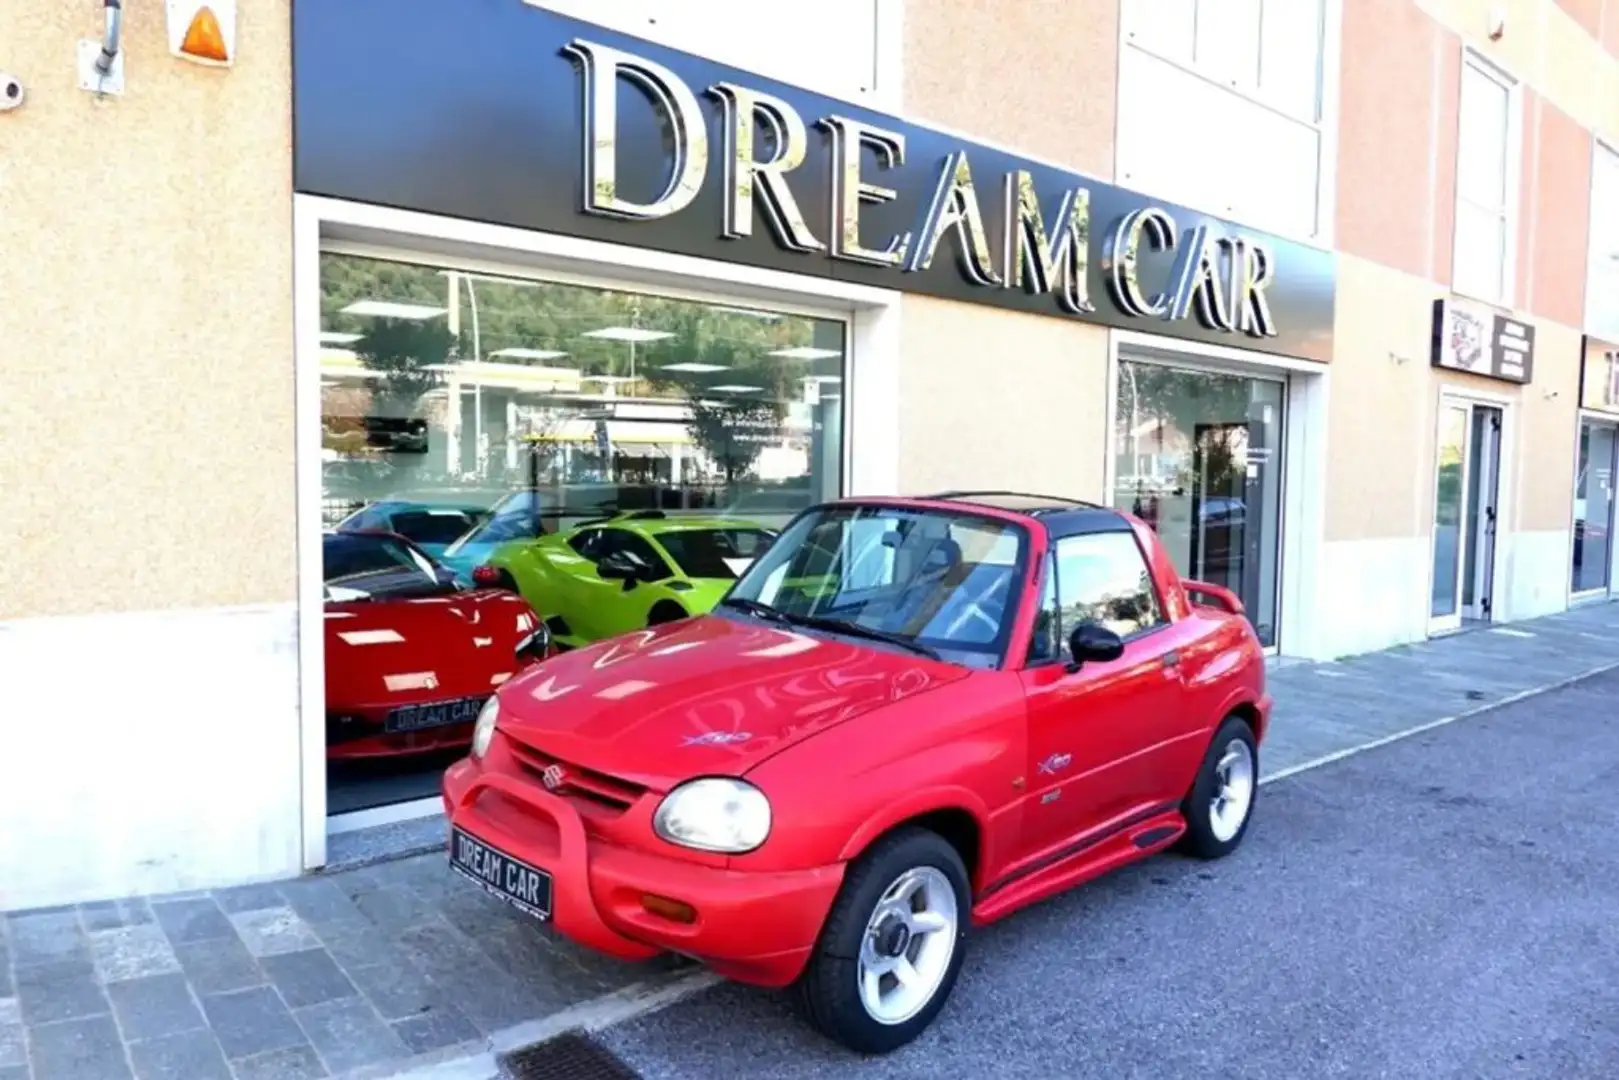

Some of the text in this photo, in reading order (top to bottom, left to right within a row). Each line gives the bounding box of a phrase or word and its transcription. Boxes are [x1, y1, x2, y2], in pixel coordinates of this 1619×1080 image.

[558, 38, 1278, 337] DREAM CAR
[458, 834, 502, 886] DREAM
[505, 863, 541, 905] CAR
